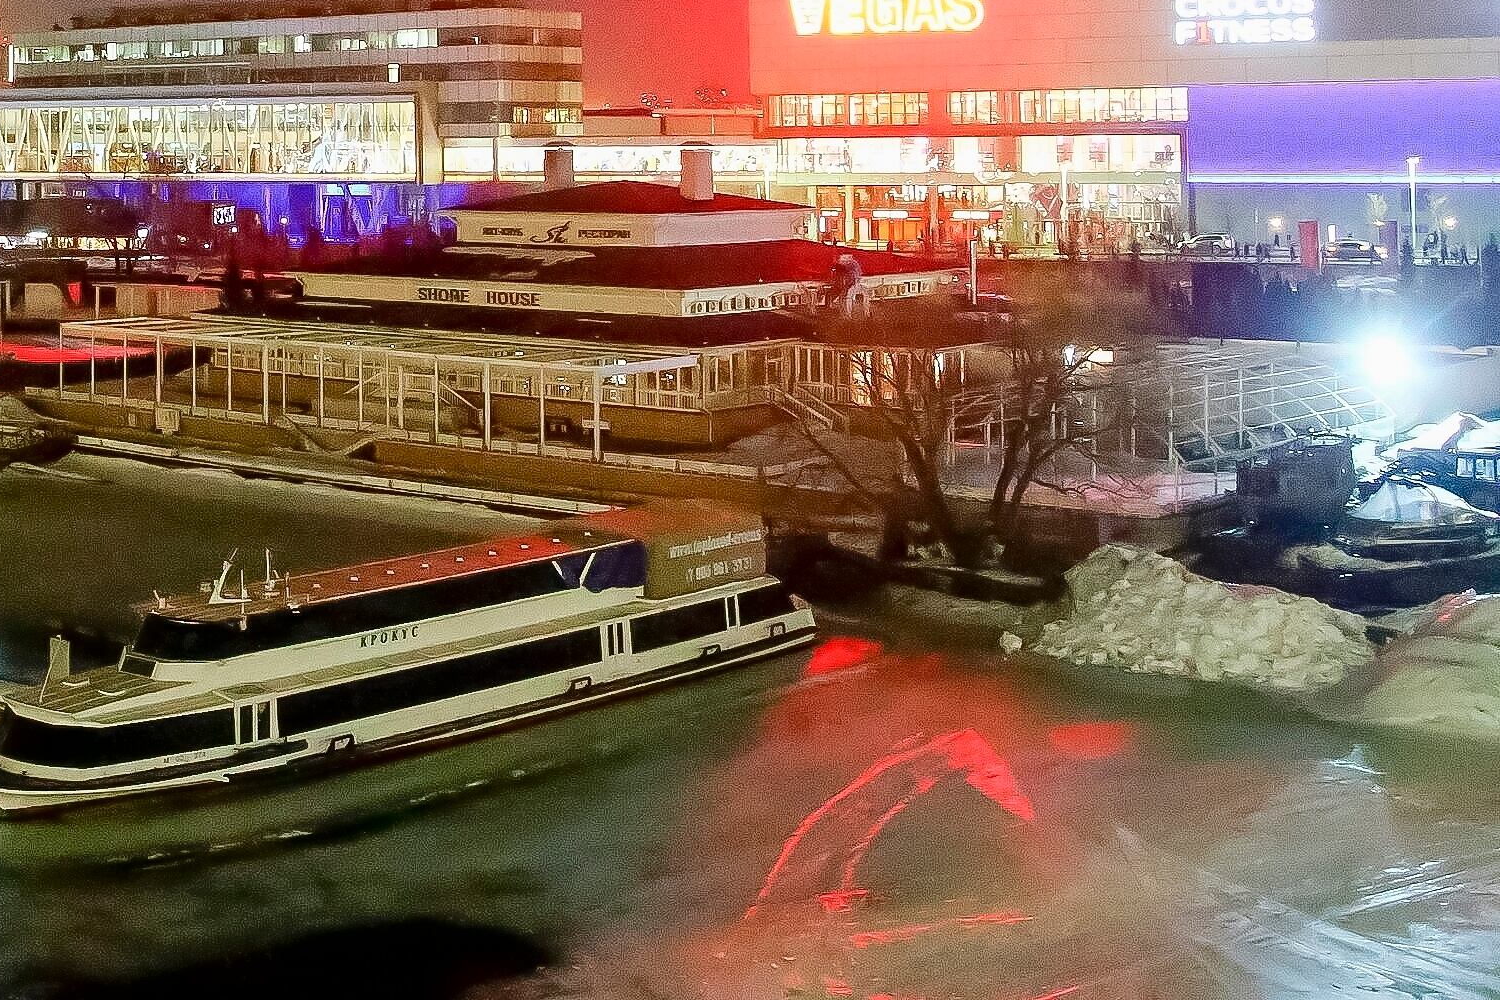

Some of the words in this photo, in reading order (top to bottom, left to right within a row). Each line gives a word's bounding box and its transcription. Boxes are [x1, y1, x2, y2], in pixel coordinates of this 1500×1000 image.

[417, 287, 470, 304] SHORE
[485, 290, 542, 307] HOUSE
[360, 625, 419, 648] КРОКУС
